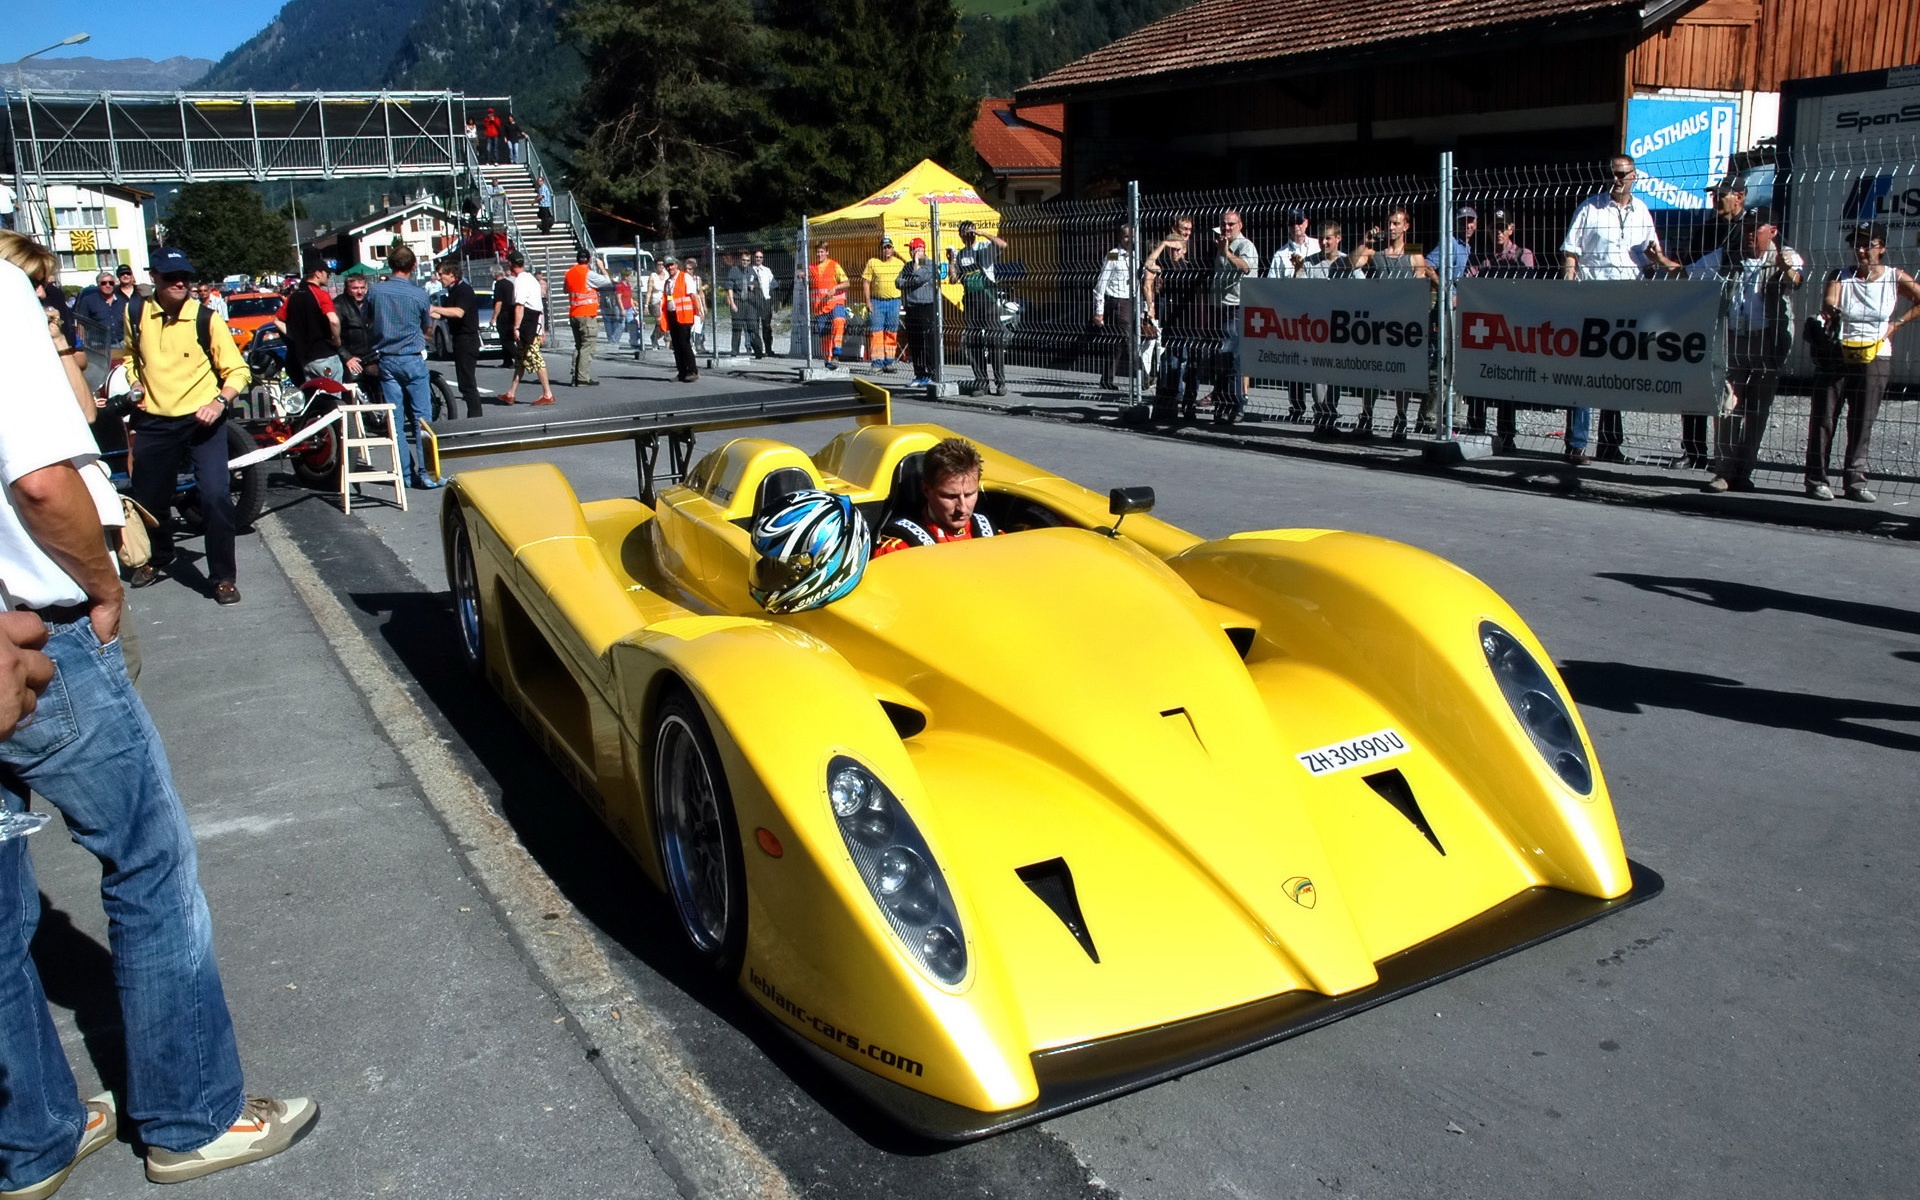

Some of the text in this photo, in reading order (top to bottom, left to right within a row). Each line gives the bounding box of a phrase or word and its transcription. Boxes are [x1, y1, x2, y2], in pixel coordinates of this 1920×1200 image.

[1630, 111, 1709, 159] GASTHAUS
[1266, 308, 1424, 348] AutoBörse
[1493, 314, 1707, 364] AutoBörse
[1258, 350, 1300, 366] Zeitschrift
[1311, 355, 1406, 374] www.autoborse.com
[1480, 363, 1537, 383] Zeitschrift
[1552, 371, 1683, 394] www.autoborse.com
[749, 967, 924, 1077] leblanc-cars.com
